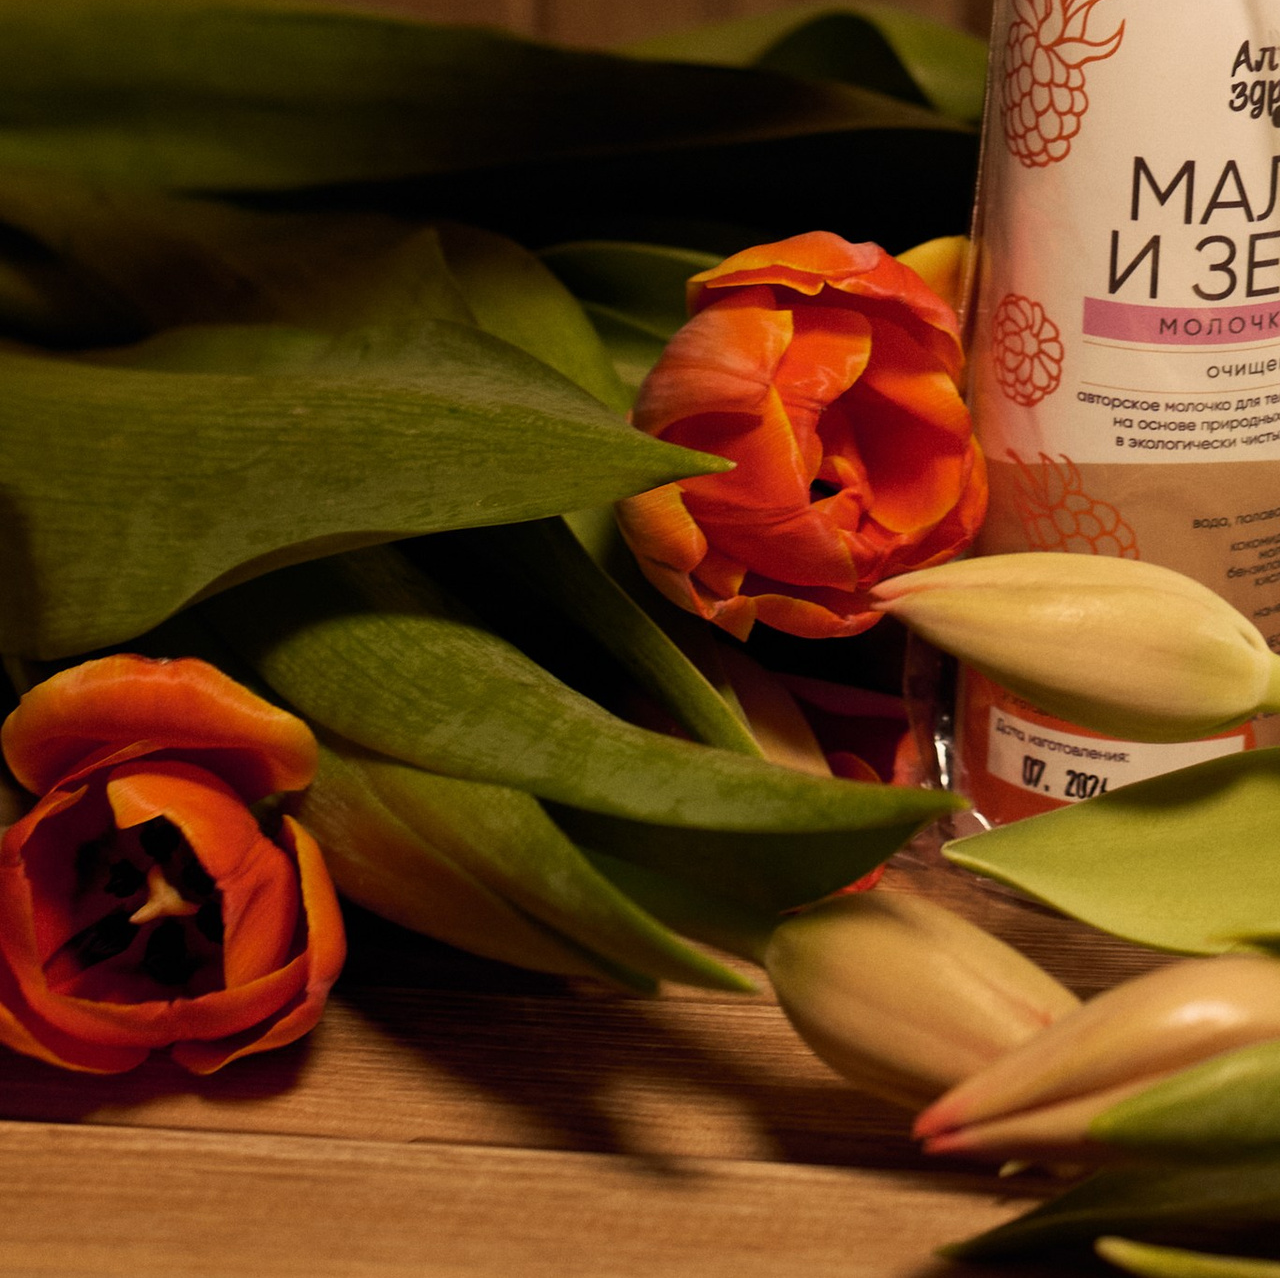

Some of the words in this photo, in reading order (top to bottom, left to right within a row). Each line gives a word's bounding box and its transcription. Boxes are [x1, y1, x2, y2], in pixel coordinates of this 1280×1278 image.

[1109, 230, 1161, 299] И
[1077, 390, 1161, 411] авторское
[1164, 399, 1231, 413] молочко
[1235, 397, 1261, 412] для
[1113, 416, 1134, 429] на
[1137, 419, 1197, 432] основе
[1115, 436, 1125, 447] в
[1128, 436, 1237, 451] экологически
[1193, 517, 1231, 530] вода,
[1028, 734, 1130, 763] изготовления:
[1022, 754, 1049, 792] 07.
